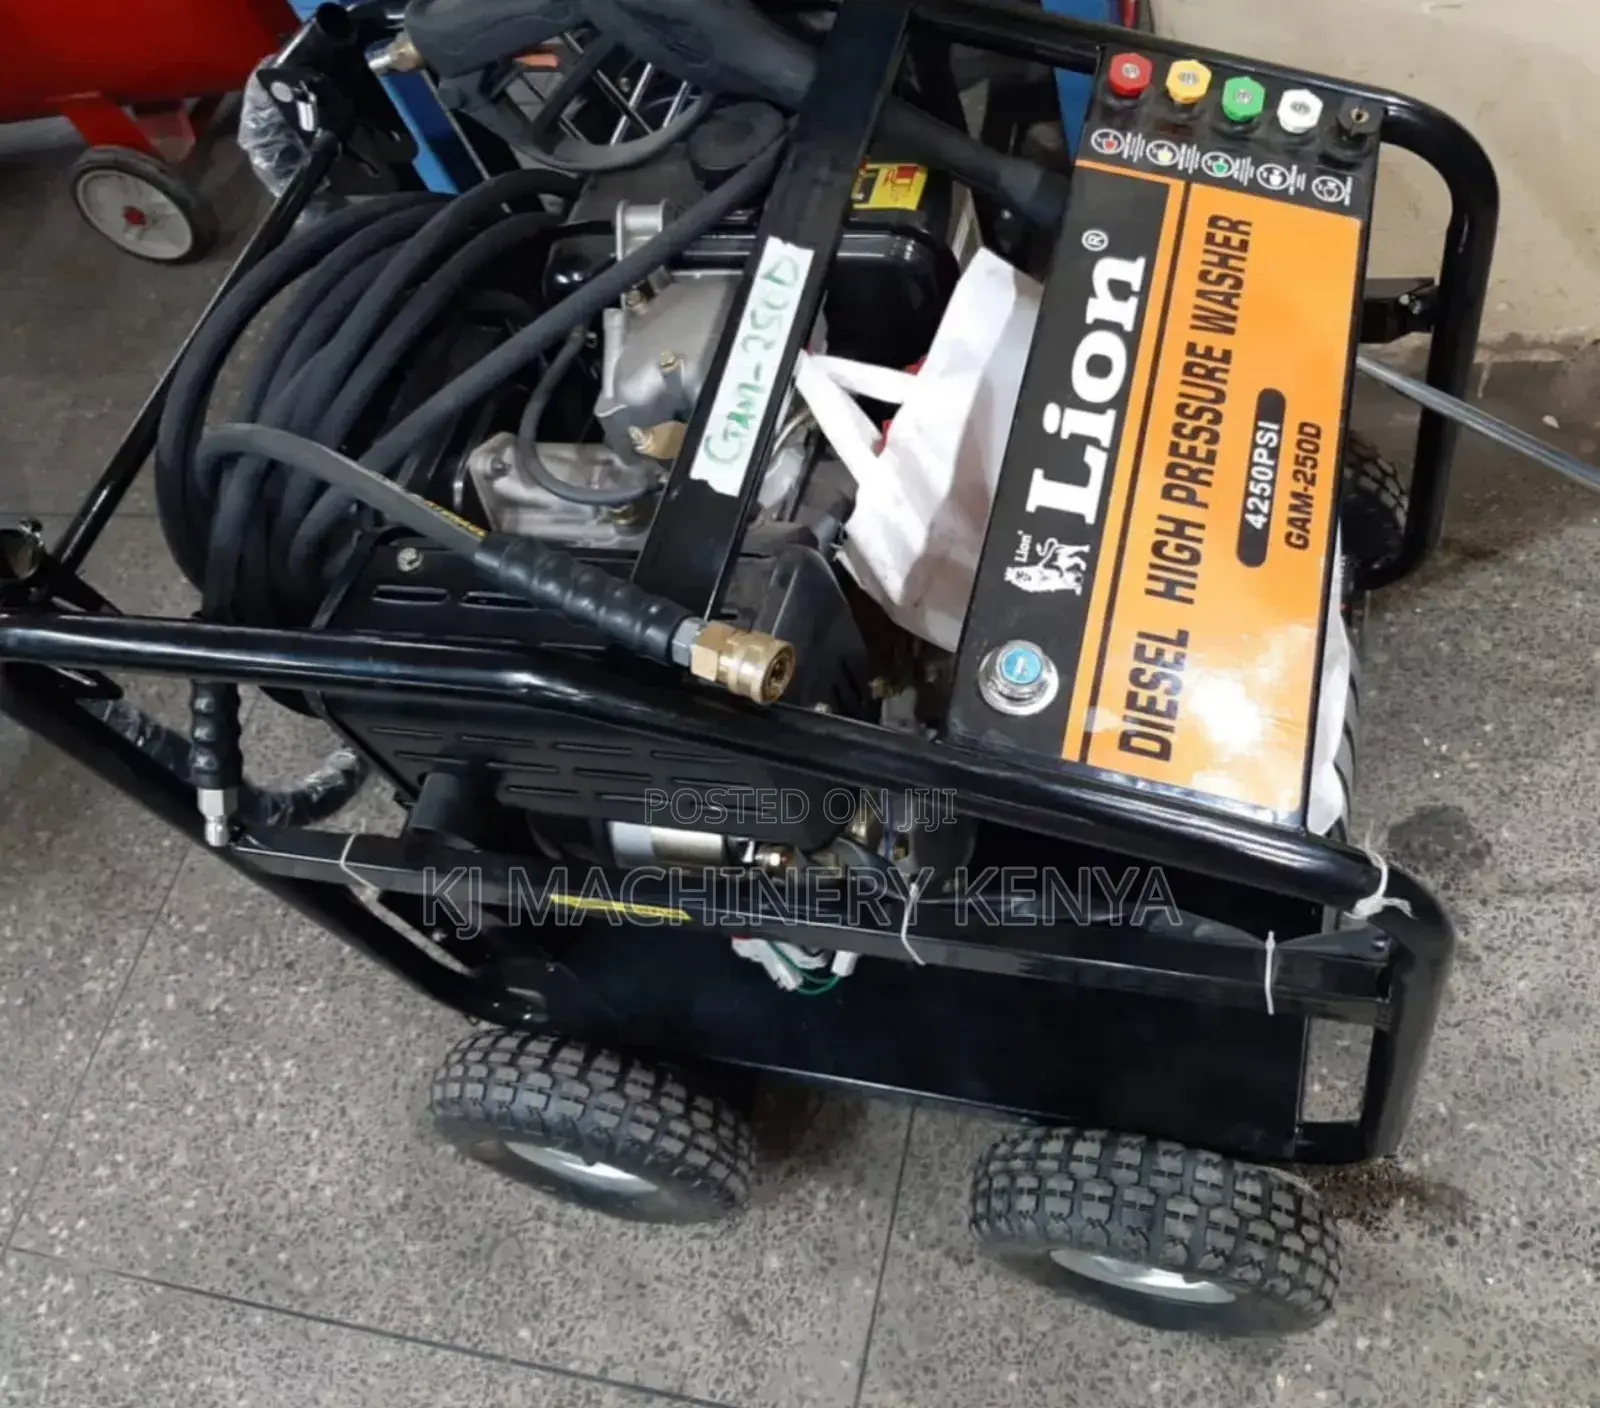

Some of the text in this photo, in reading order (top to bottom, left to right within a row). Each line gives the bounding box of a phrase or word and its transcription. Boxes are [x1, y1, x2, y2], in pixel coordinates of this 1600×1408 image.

[1117, 213, 1253, 762] DIESEL HIGH PRESSURE WASHER
[1244, 420, 1281, 530] 4250PSI
[1284, 421, 1322, 551] GAM-250D
